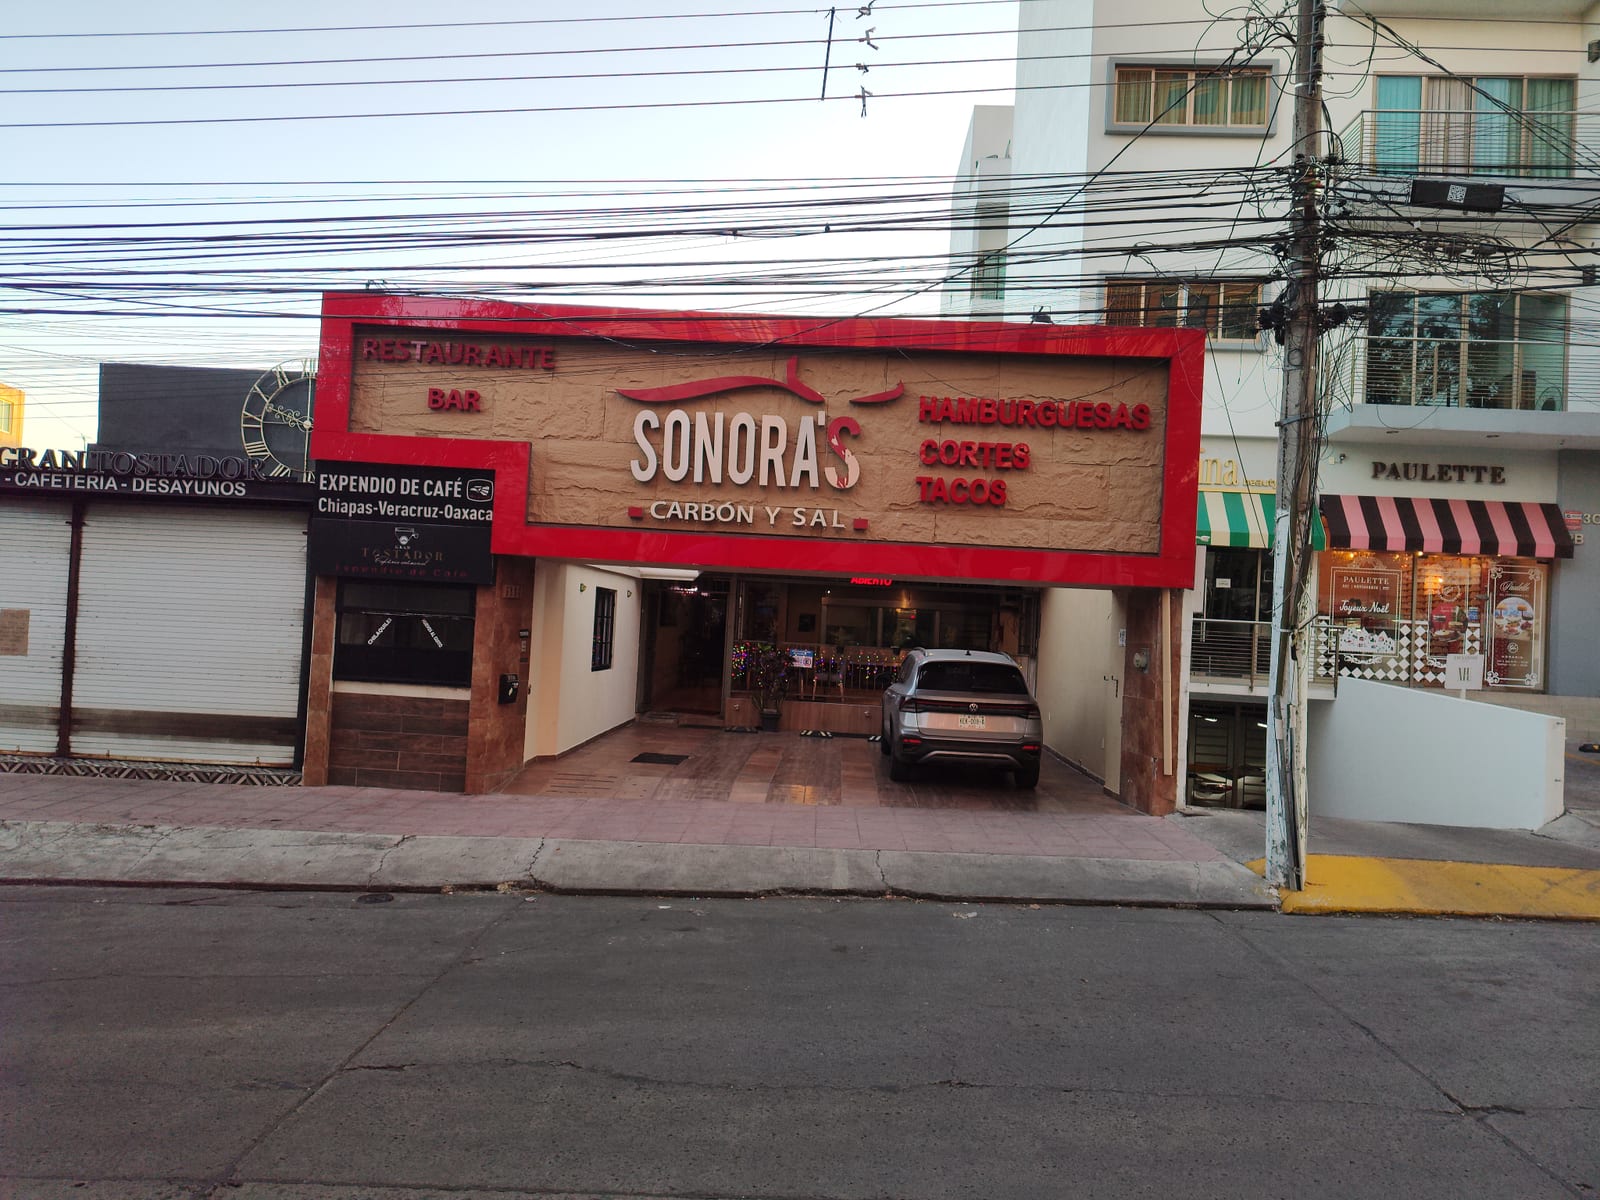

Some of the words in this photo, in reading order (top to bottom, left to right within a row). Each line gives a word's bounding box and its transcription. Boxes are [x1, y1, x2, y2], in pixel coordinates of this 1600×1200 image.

[362, 339, 555, 369] RESTAURANTE
[428, 387, 480, 413] BAR
[918, 395, 1150, 430] HAMBURGUESAS
[629, 408, 861, 490] SONORA'S
[919, 439, 1031, 469] CORTES
[0, 446, 88, 473] GRAN
[90, 450, 268, 481] TOSTADOR
[1371, 461, 1506, 485] PAULETTE
[132, 477, 246, 496] DESAYUNOS
[319, 474, 396, 495] EXPENDIO
[400, 479, 420, 496] DE
[423, 477, 462, 498] CAFÉ
[916, 476, 1007, 505] TACOS
[318, 498, 493, 521] Chiapas-Veracruz-Oaxaca
[650, 501, 754, 524] CARBÓN
[765, 507, 781, 525] Y
[792, 508, 846, 528] SAL
[361, 547, 444, 562] TOSTADOR
[1343, 576, 1390, 585] PAULETTE
[1340, 600, 1367, 615] Joyeux
[1368, 602, 1390, 614] Noël
